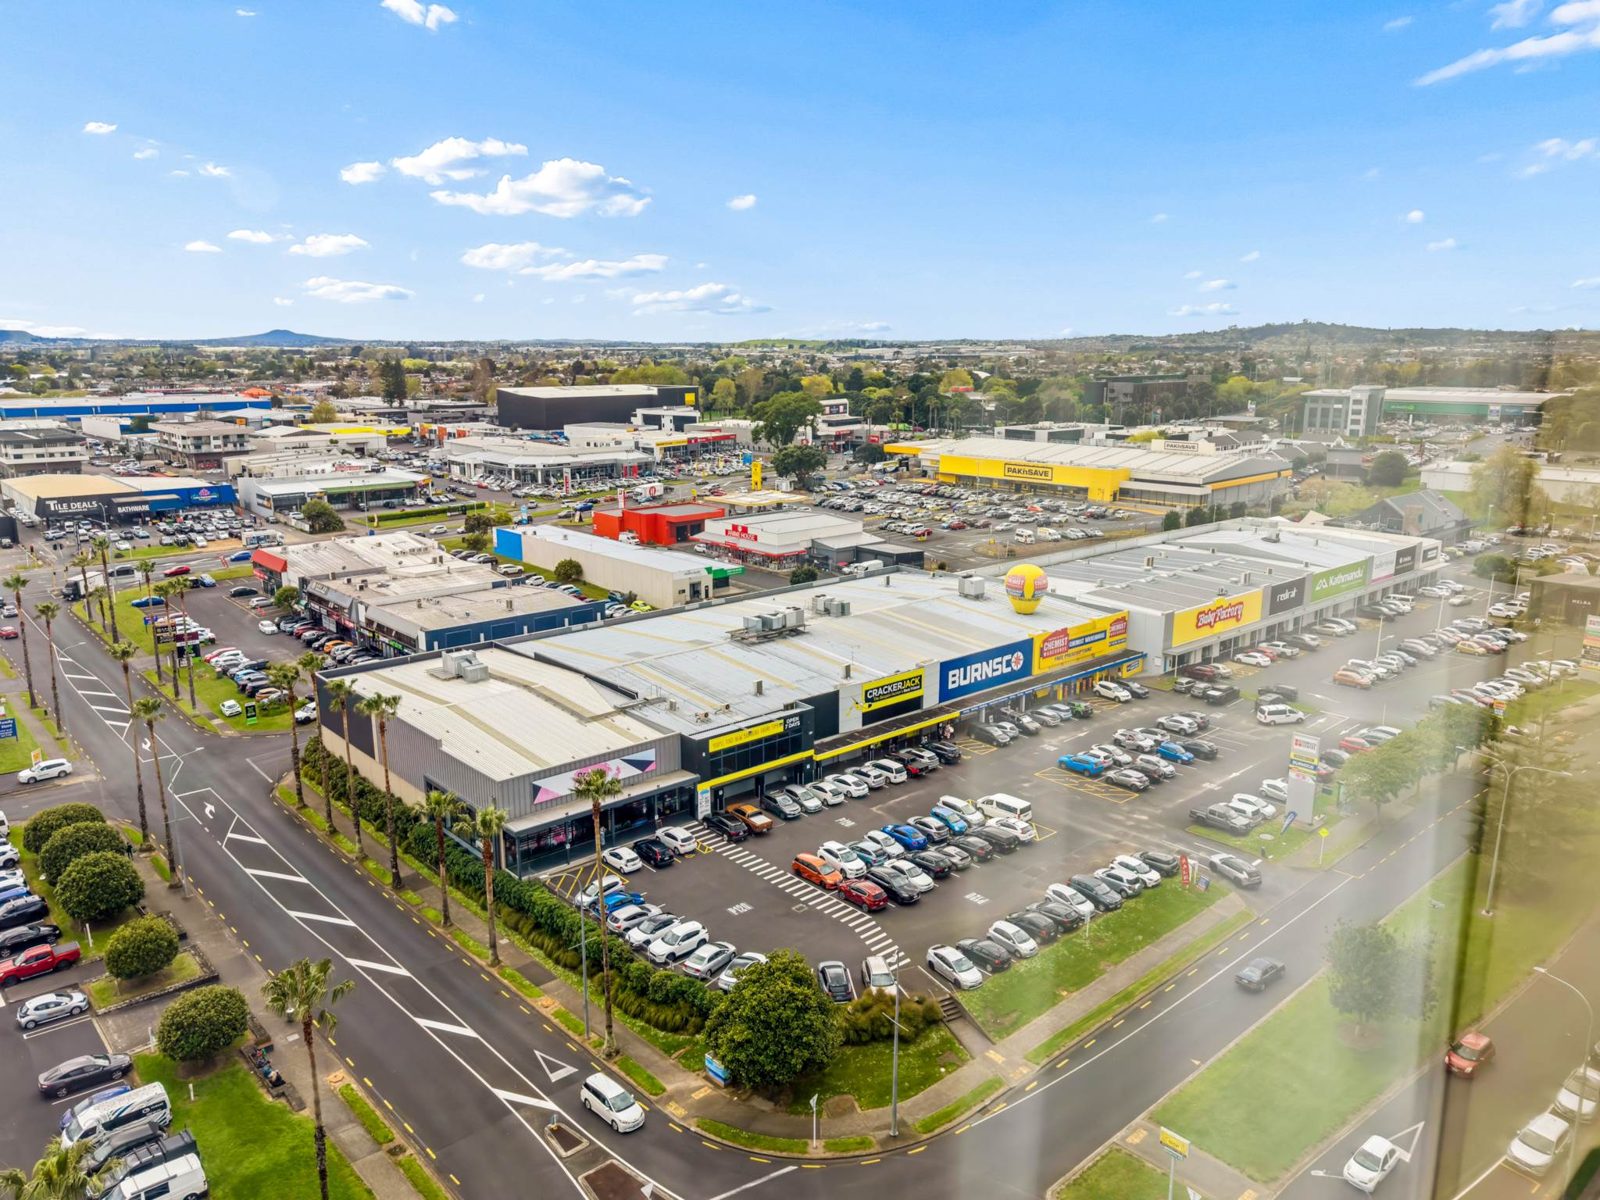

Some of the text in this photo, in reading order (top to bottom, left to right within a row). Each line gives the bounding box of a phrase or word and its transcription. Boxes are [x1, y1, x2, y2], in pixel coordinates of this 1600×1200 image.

[45, 501, 69, 511] TILE
[70, 500, 97, 509] DEALS
[1329, 566, 1364, 586] Kathmandu
[1043, 637, 1068, 652] CHEMIST
[948, 651, 1024, 690] BURNSCO
[867, 676, 920, 698] CRACKERJACK
[786, 716, 799, 724] OPEN
